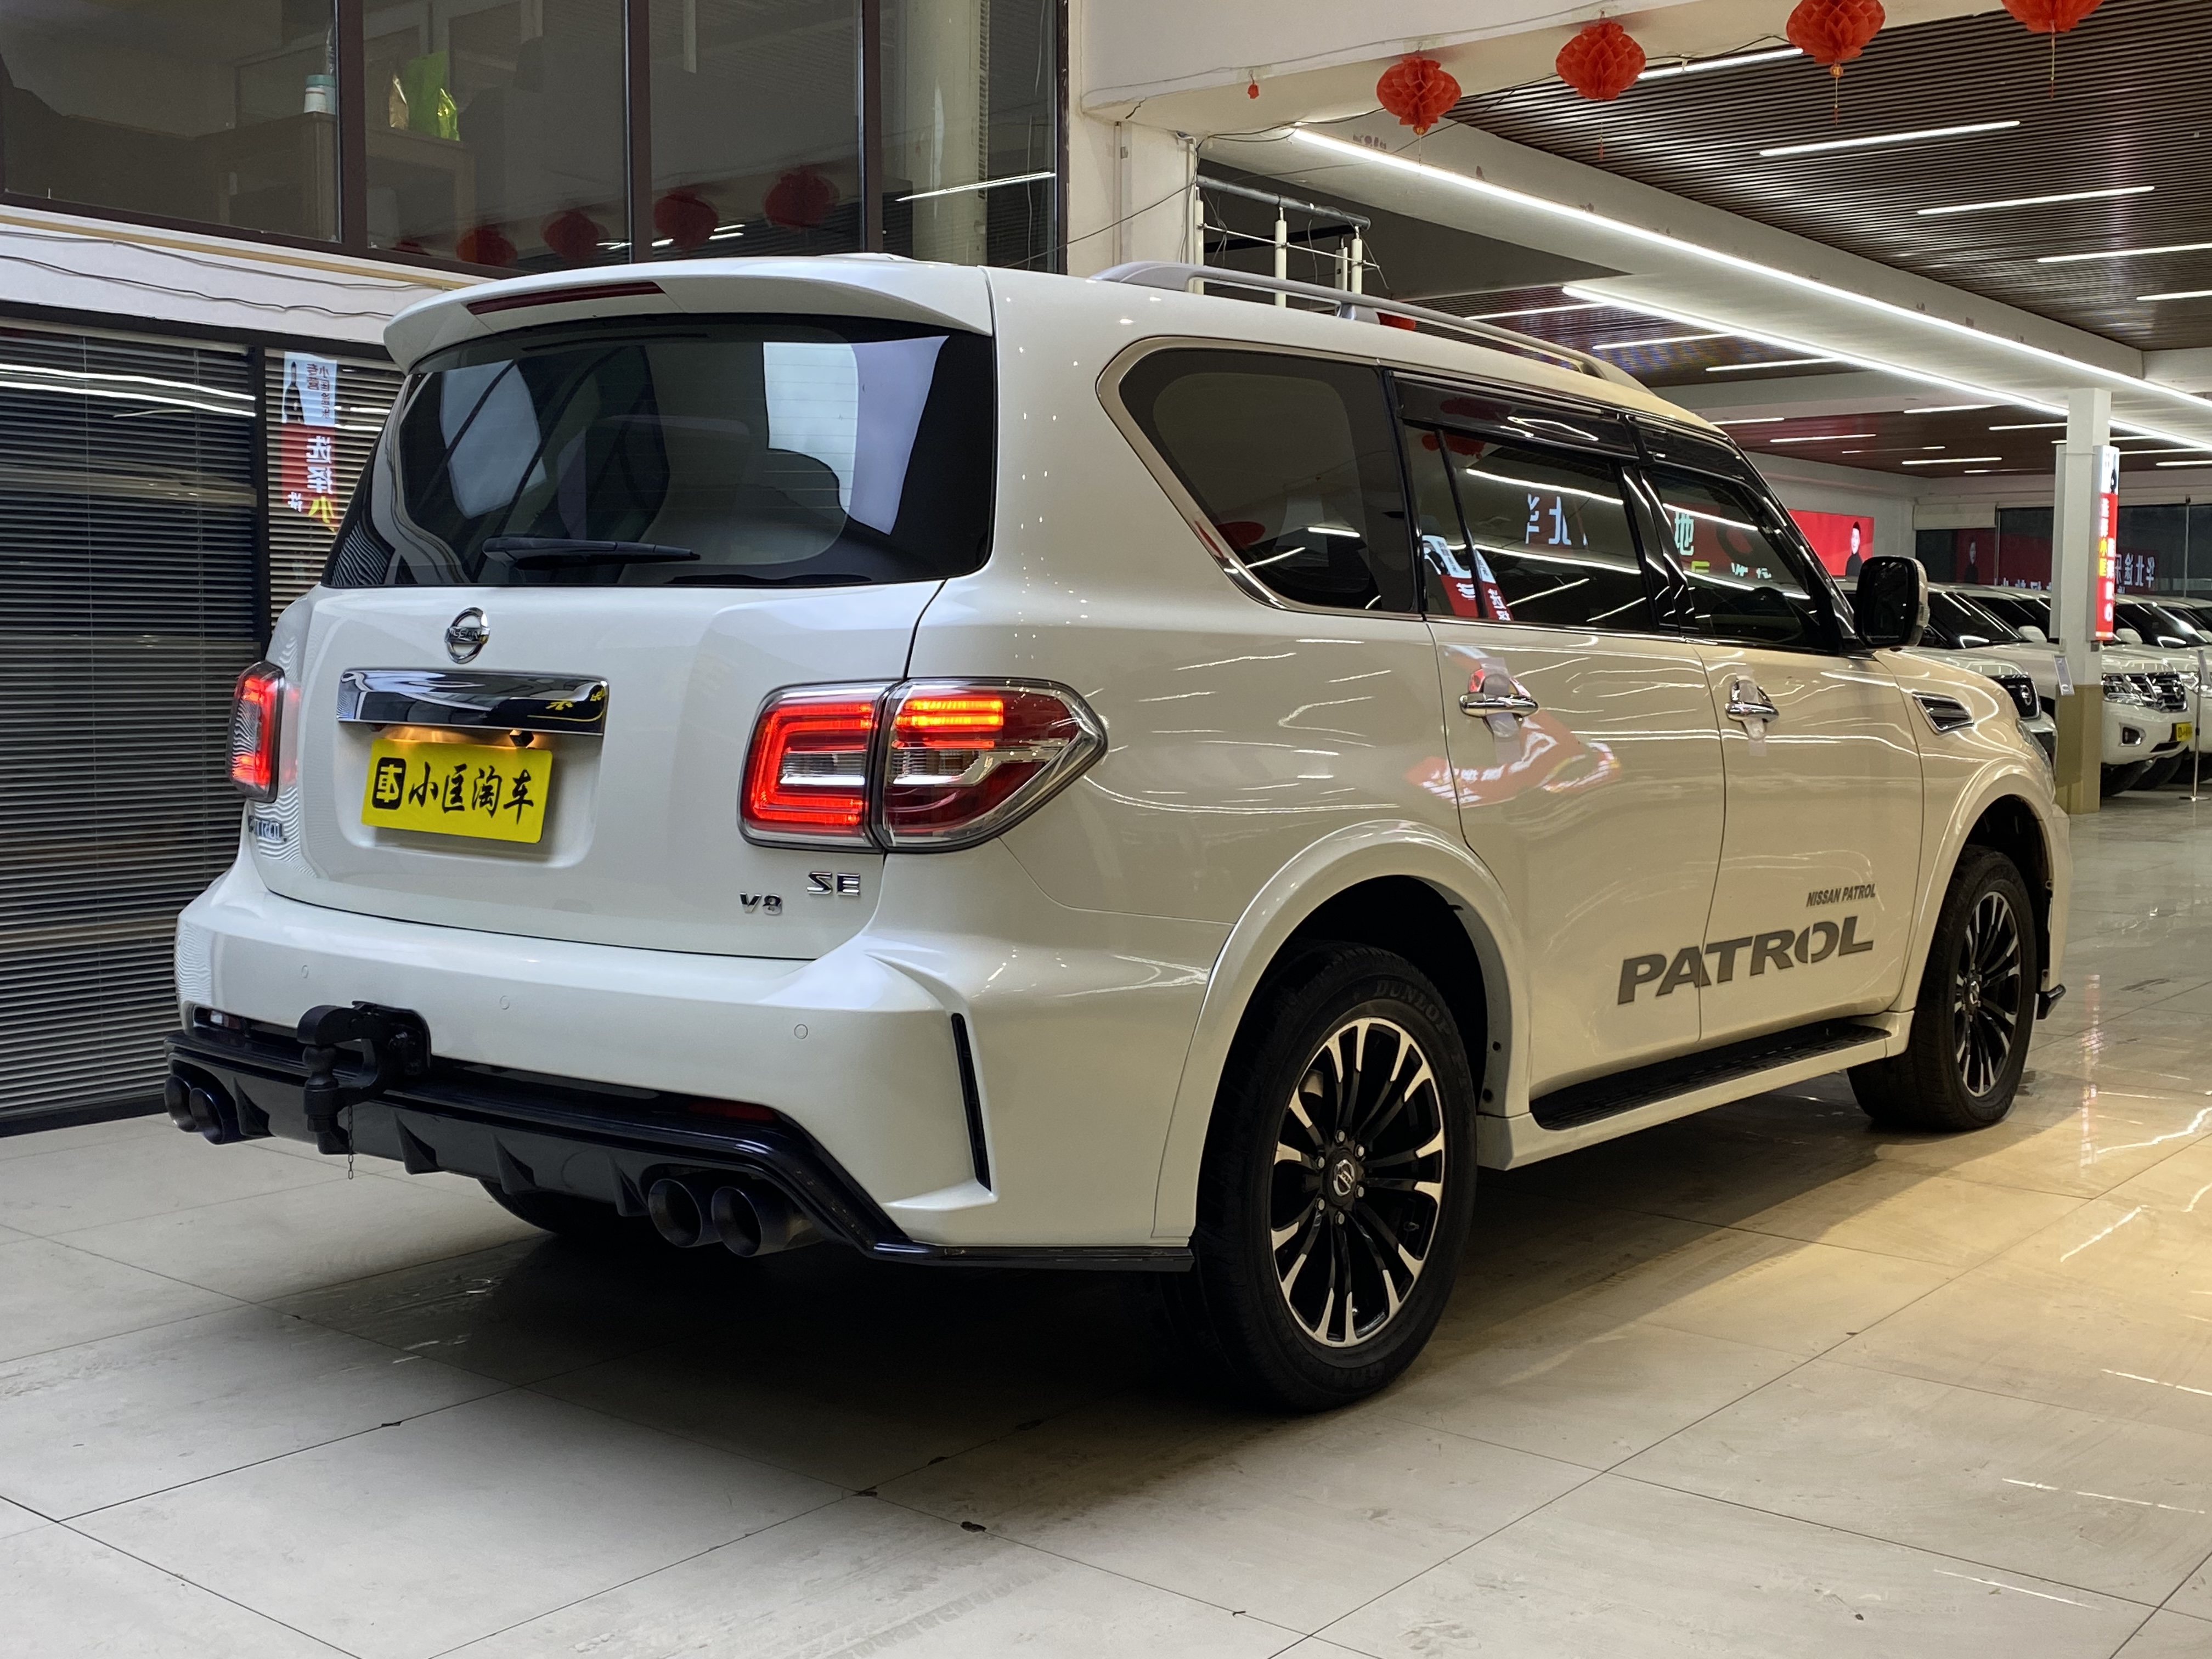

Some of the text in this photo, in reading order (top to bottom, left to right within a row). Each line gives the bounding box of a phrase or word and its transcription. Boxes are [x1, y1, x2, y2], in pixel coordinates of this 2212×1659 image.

[408, 761, 534, 825] 小匡淘车
[806, 871, 860, 896] SE
[1806, 883, 1876, 907] NISSAN PATROL
[740, 892, 783, 916] V8
[1617, 916, 1874, 1006] PATROL
[1373, 979, 1452, 1035] DUNLOP
